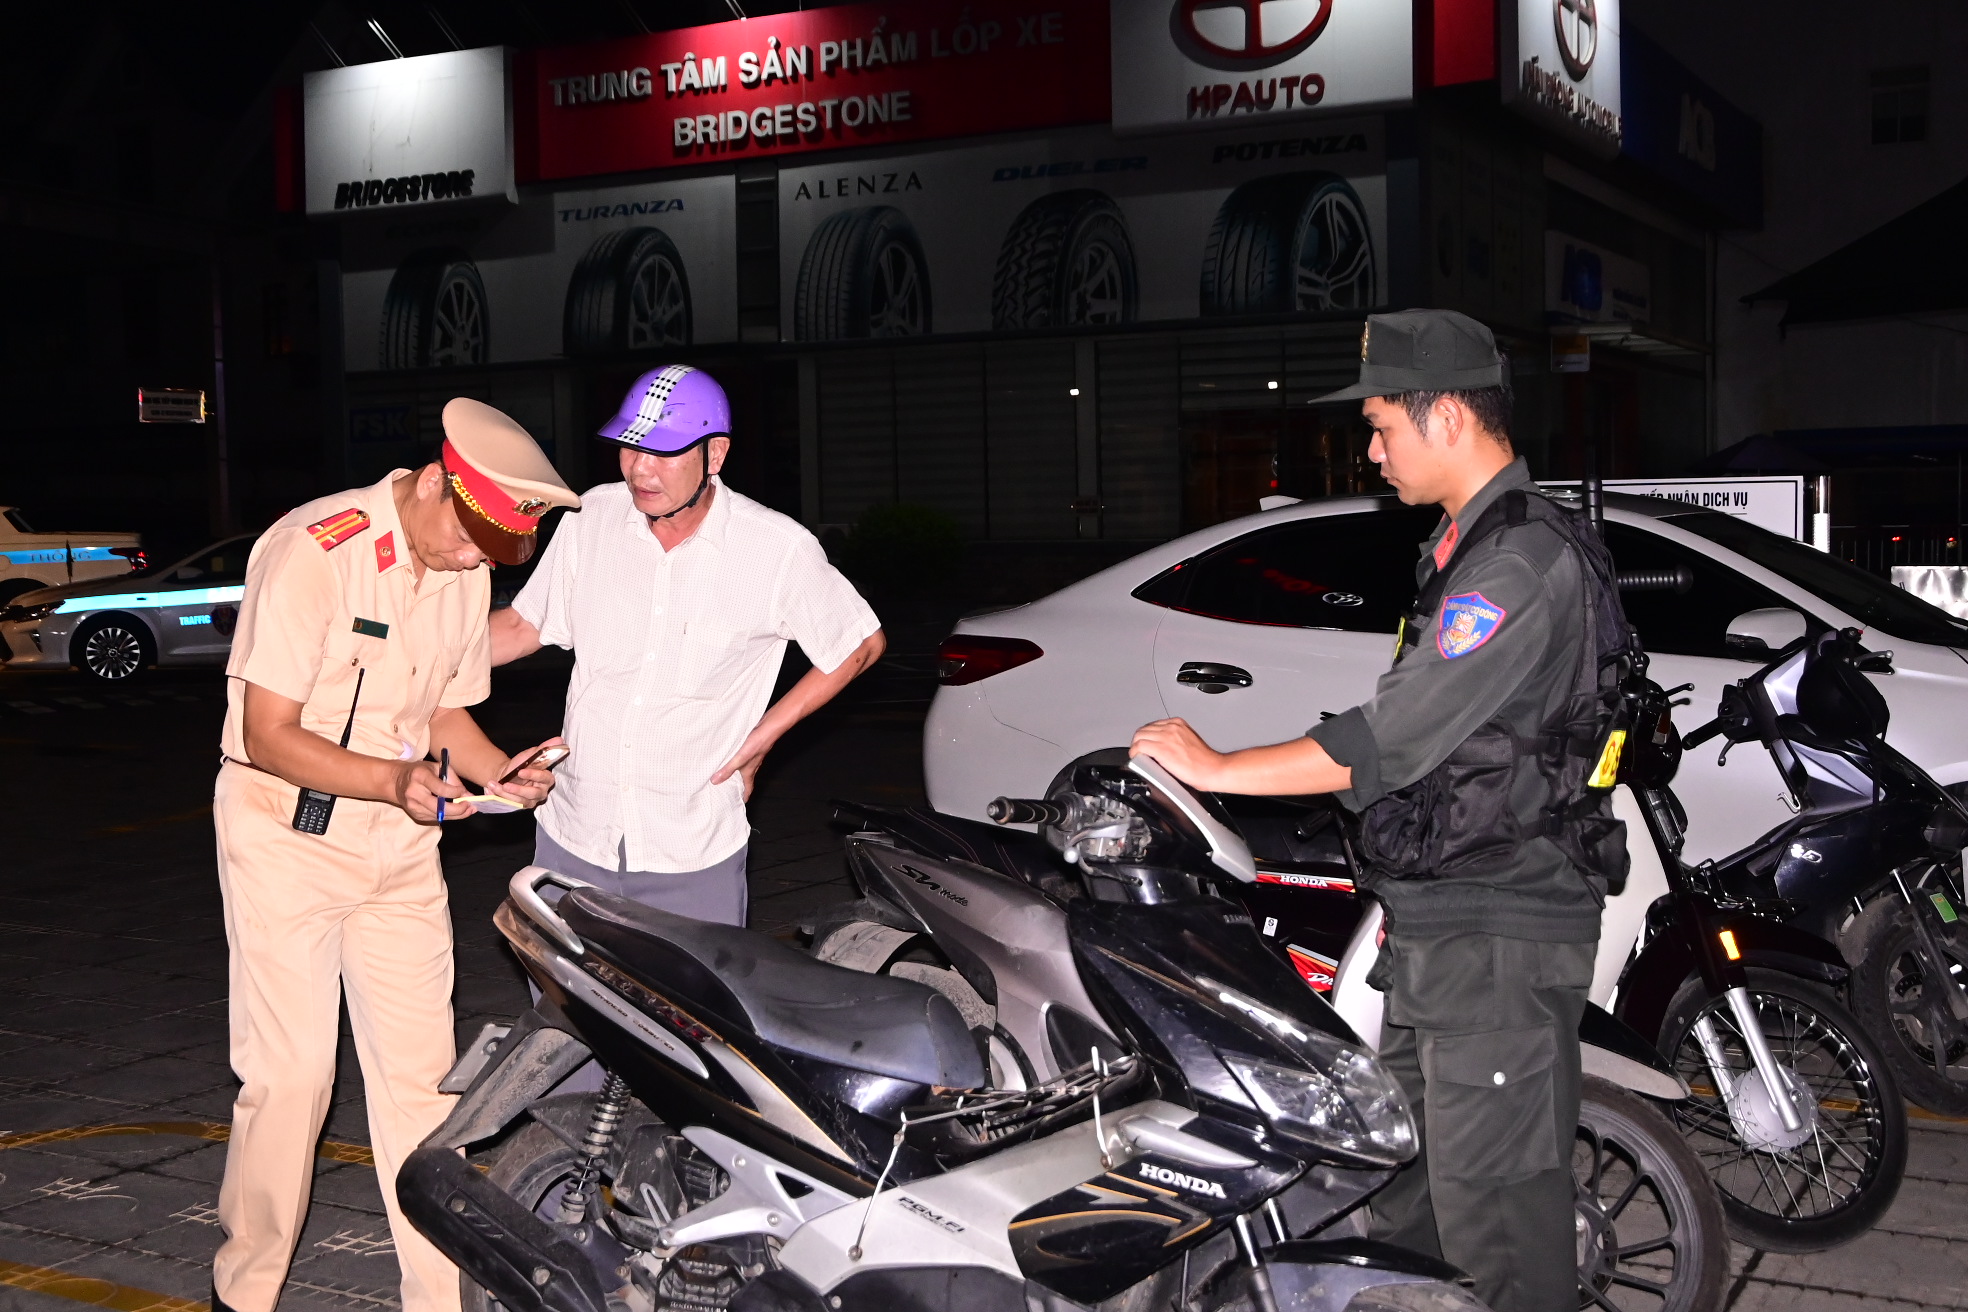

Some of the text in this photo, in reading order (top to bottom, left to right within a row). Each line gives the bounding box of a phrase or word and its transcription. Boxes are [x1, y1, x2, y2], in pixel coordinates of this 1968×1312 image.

[549, 5, 1066, 106] TRUNG TÂM SẢN PHẨM LỐP XE
[1189, 73, 1325, 118] HPAUTO
[674, 90, 914, 147] BRIDGESTONE
[1212, 133, 1368, 164] POTENZA
[992, 156, 1149, 183] DUELER
[333, 169, 475, 209] BRIDGESTONE
[794, 171, 923, 201] ALENZA
[557, 198, 685, 223] TURANZA
[352, 410, 407, 439] FSK
[1733, 491, 1749, 510] VỤ
[179, 614, 212, 626] TRAFFIC
[1281, 874, 1328, 888] HONDA
[1138, 1162, 1228, 1200] HONDA
